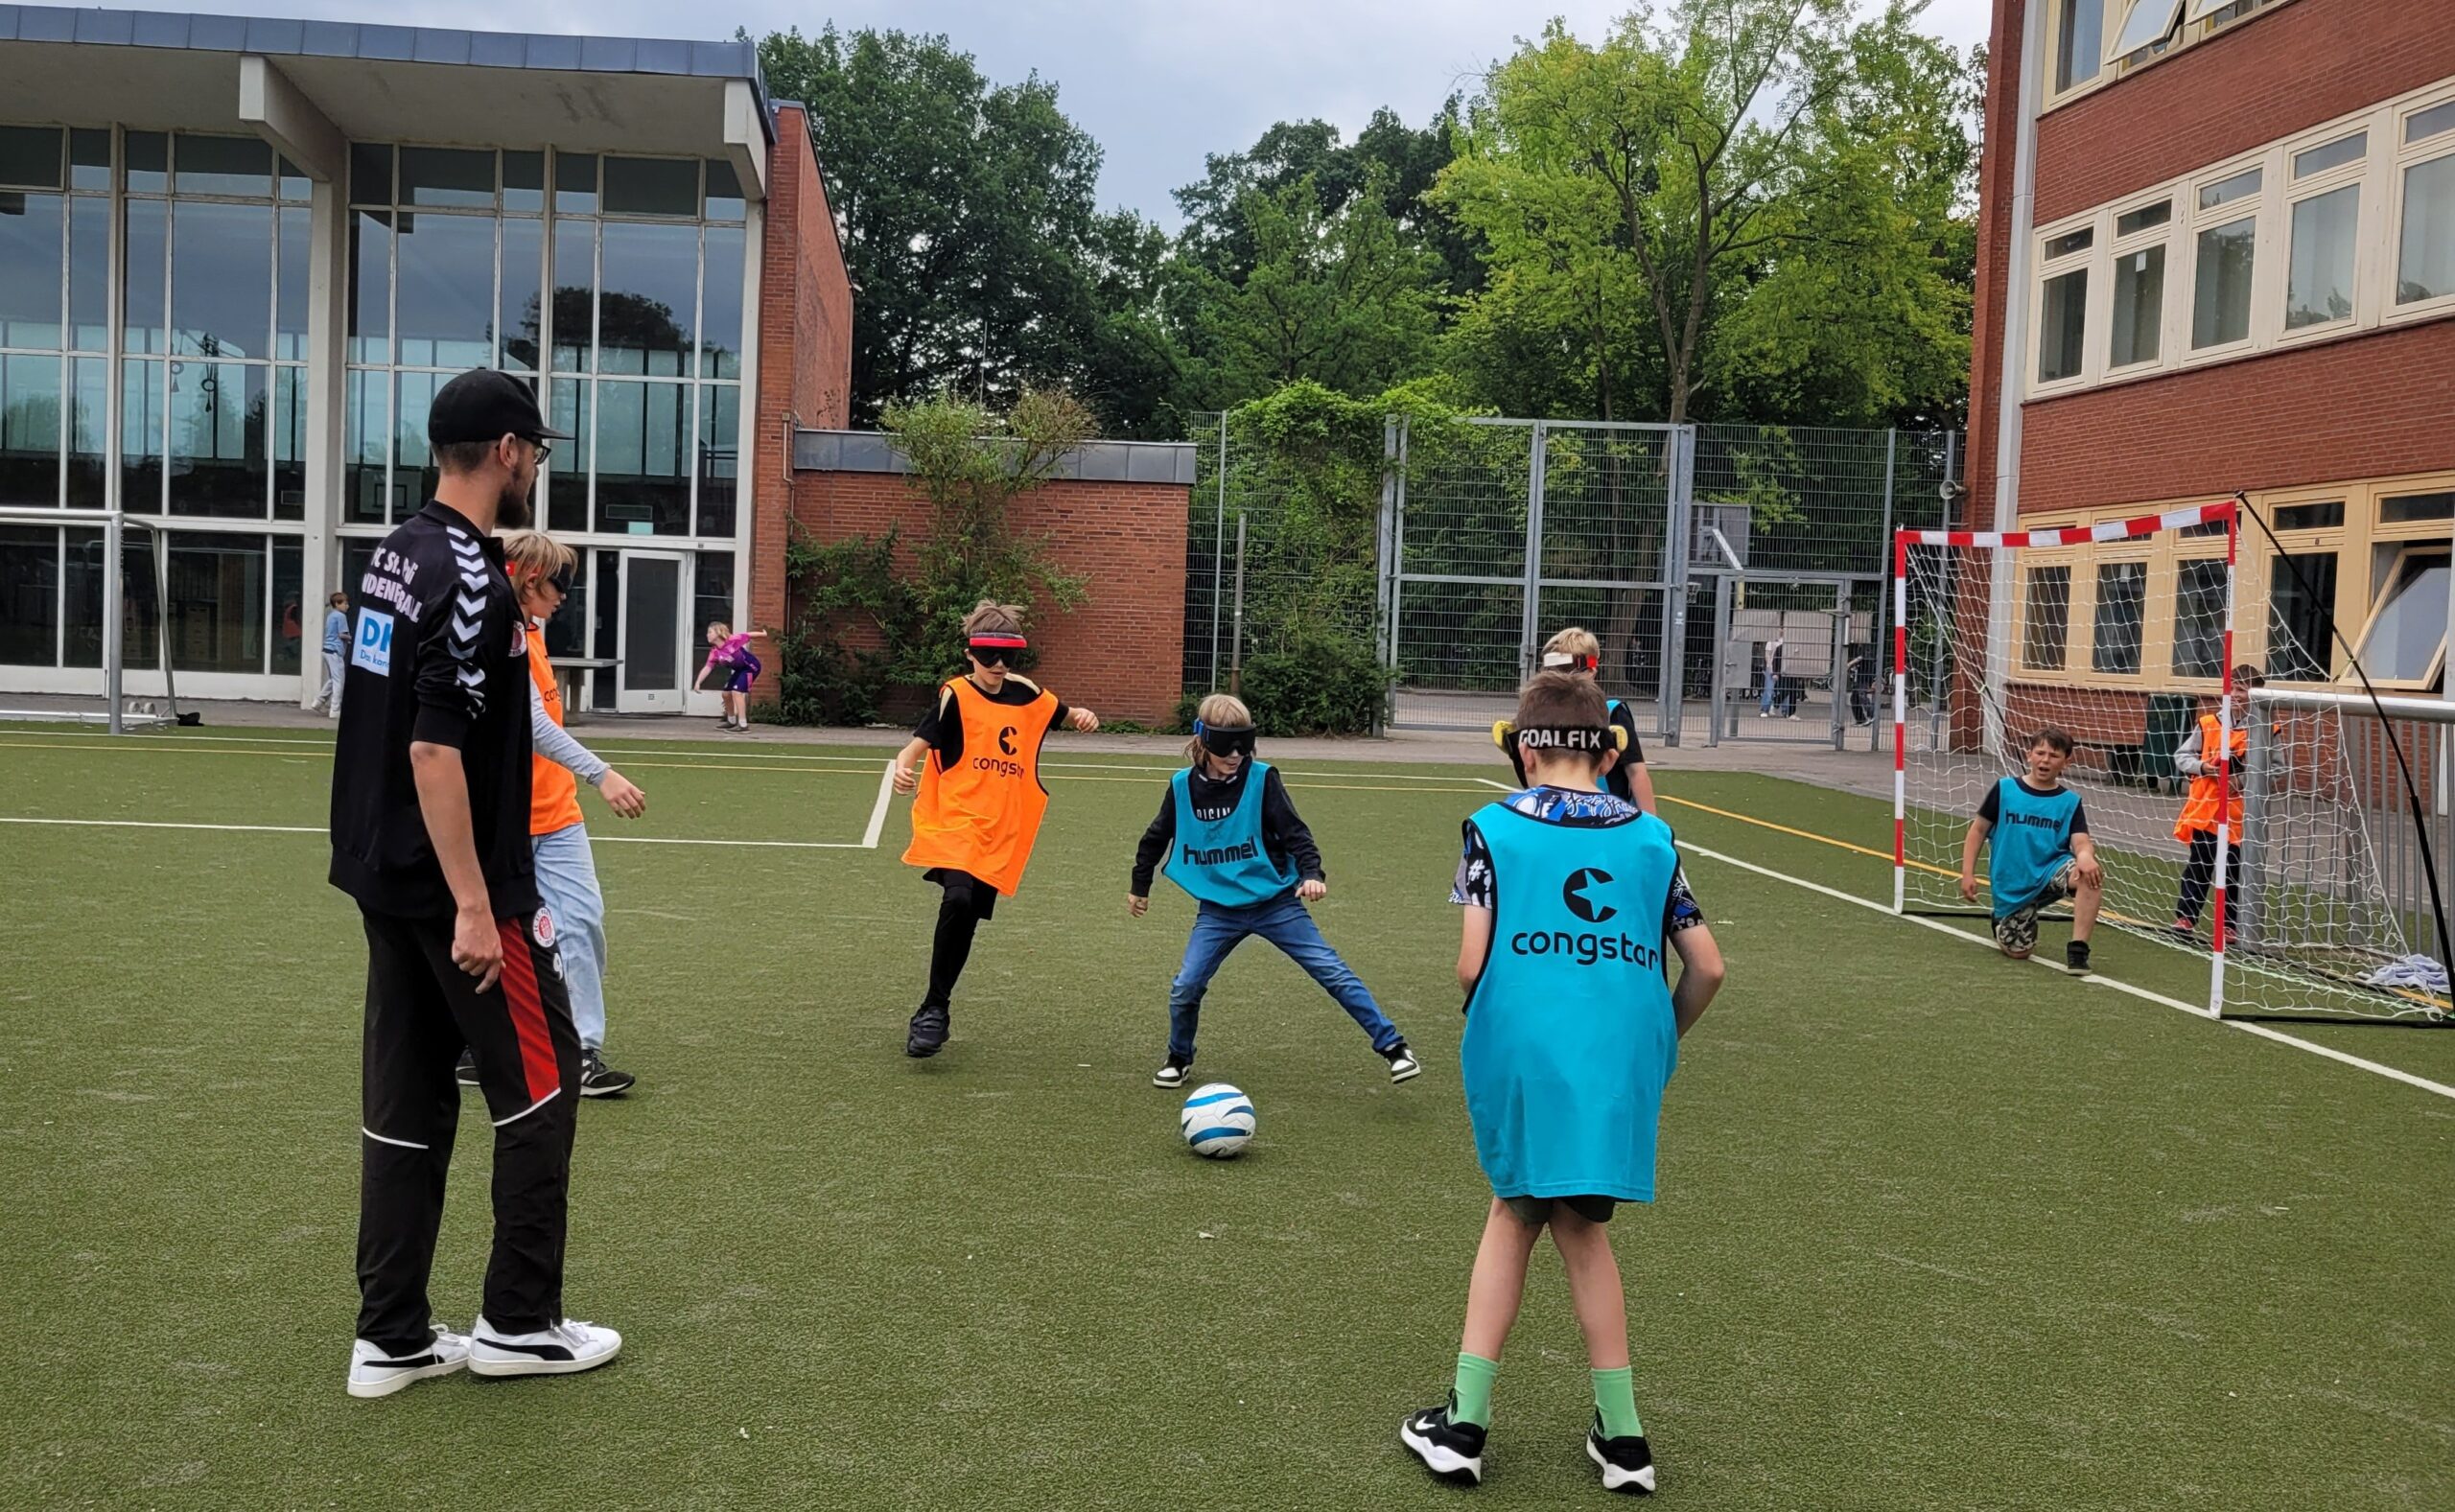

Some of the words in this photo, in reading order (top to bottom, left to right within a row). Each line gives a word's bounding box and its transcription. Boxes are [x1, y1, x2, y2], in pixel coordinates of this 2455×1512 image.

[384, 551, 401, 575] St.
[1519, 729, 1601, 748] GOALFIX
[1183, 836, 1258, 865] hummel
[1511, 931, 1658, 971] congstar
